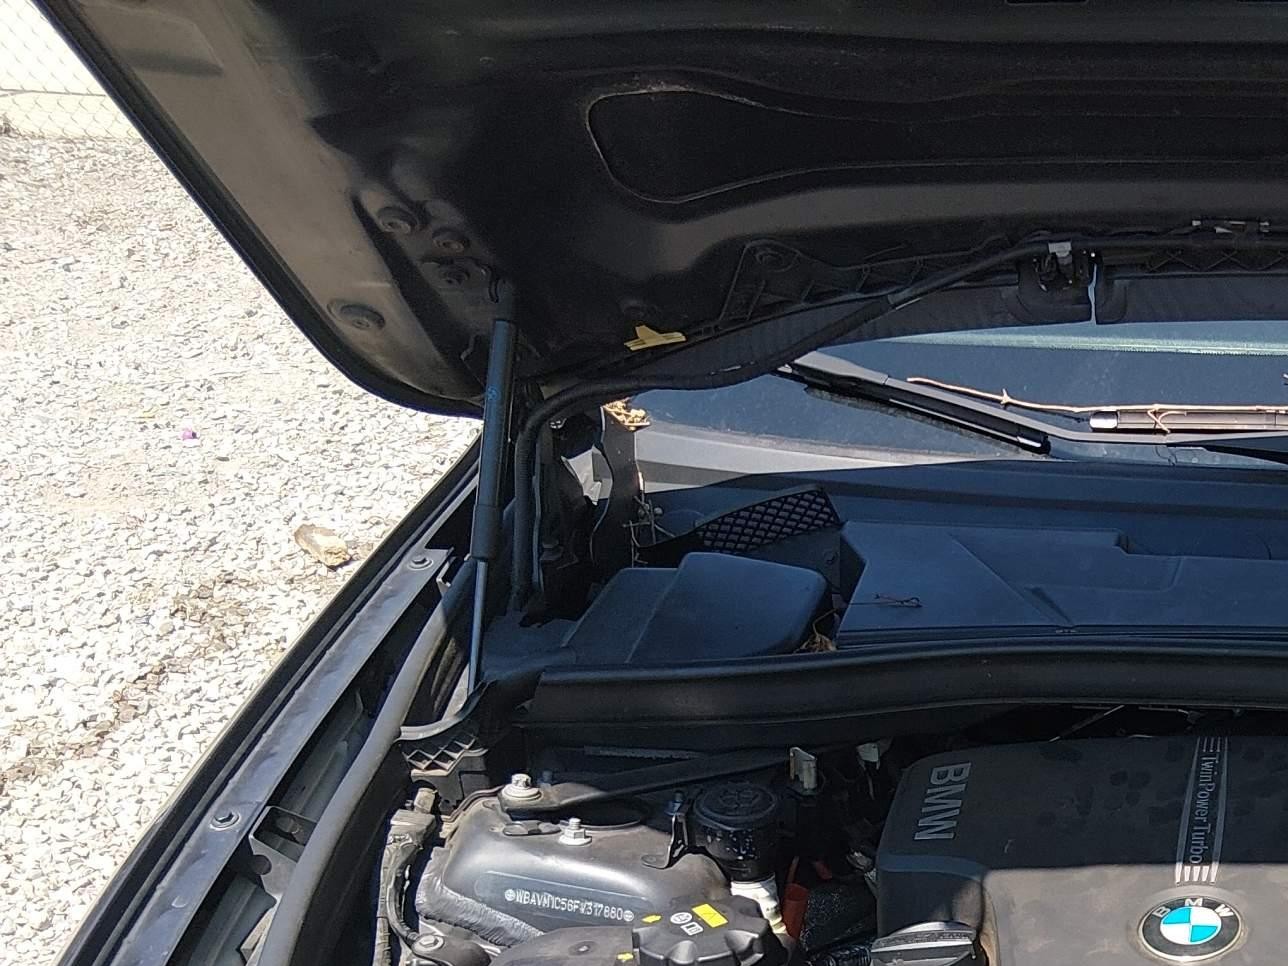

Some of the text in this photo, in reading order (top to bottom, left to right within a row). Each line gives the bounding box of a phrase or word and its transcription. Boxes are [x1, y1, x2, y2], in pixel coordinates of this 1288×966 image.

[913, 762, 972, 840] BMW
[1189, 754, 1219, 864] TwinPower Turbo
[1152, 897, 1235, 918] BMW
